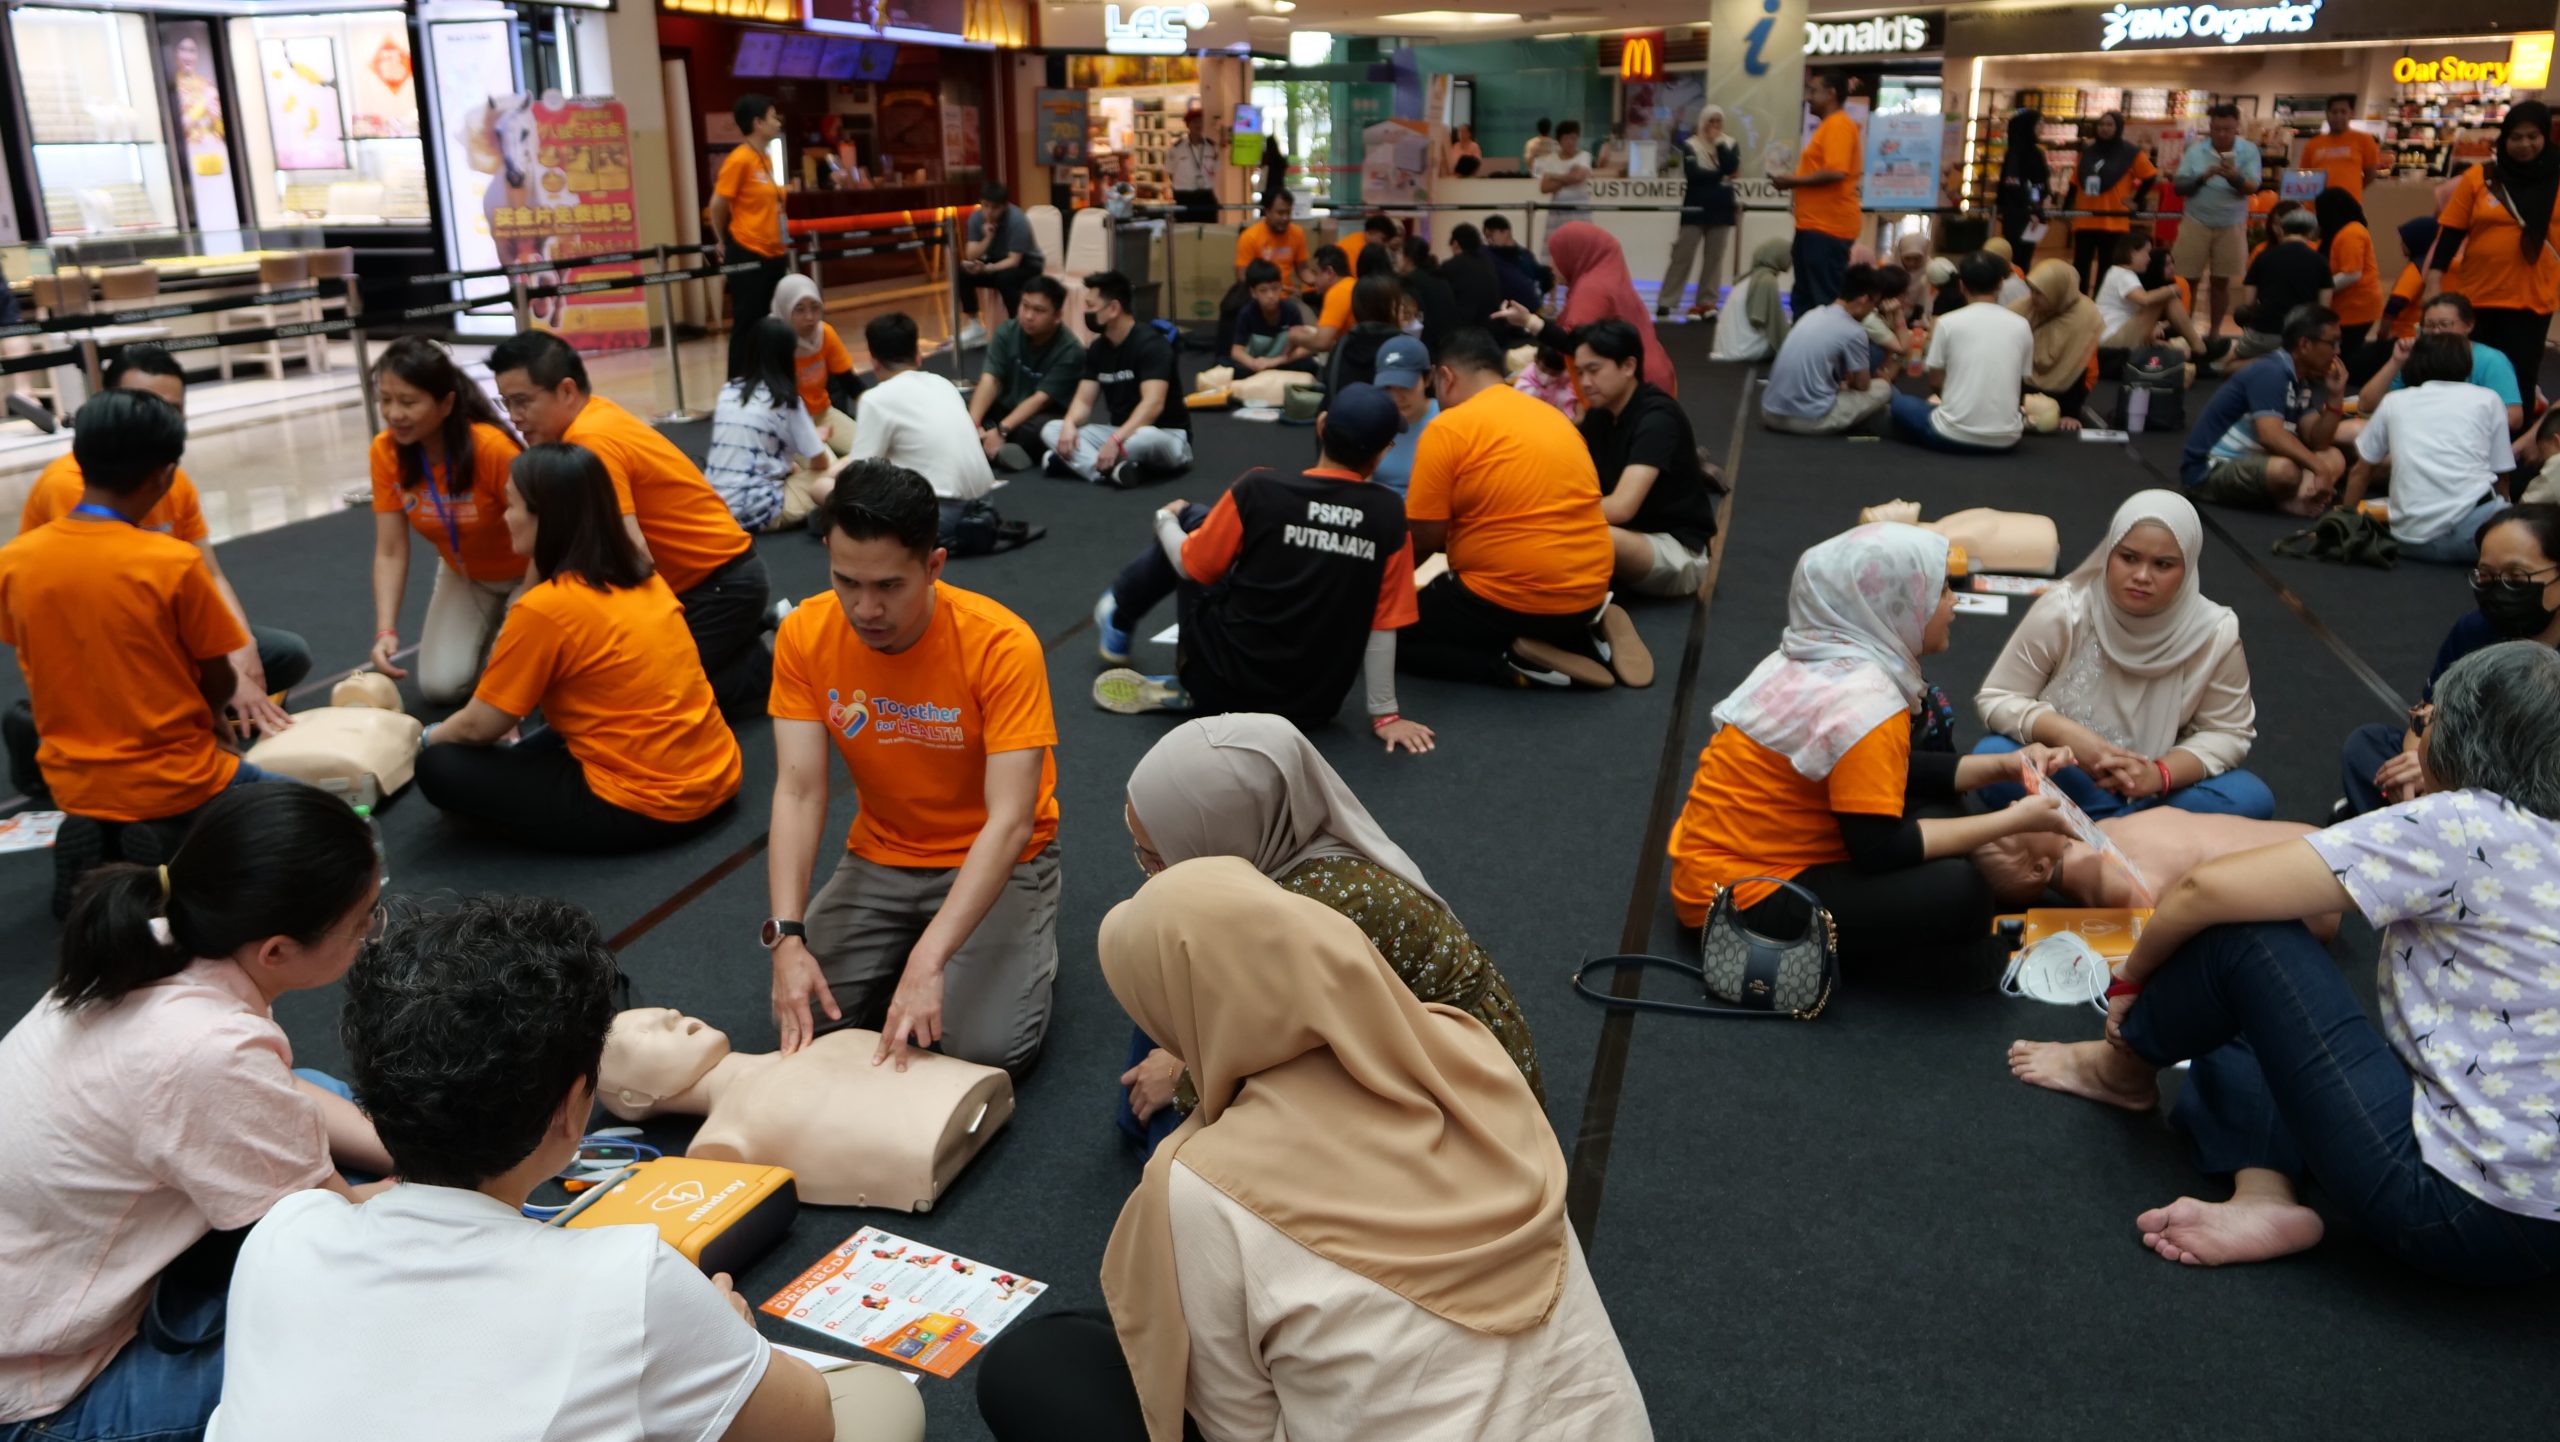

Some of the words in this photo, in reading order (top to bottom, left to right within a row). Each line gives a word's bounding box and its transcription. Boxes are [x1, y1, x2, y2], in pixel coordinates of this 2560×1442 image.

[1105, 4, 1187, 38] LAC
[1803, 15, 1927, 55] Donald's
[2128, 5, 2191, 41] BMS
[2189, 0, 2316, 43] Organics
[2393, 57, 2440, 83] Oat
[2440, 56, 2512, 86] Story
[1587, 180, 1688, 198] USTOMER
[1733, 181, 1790, 198] RVICE
[2285, 182, 2319, 194] EXIT
[1307, 501, 1364, 529] PSKPP
[1283, 524, 1376, 562] PUTRAJAYA
[872, 697, 962, 722] Together
[875, 720, 896, 732] for
[897, 719, 964, 742] HEALTH
[687, 1179, 746, 1222] mindray
[775, 1257, 845, 1310] DRSABCD
